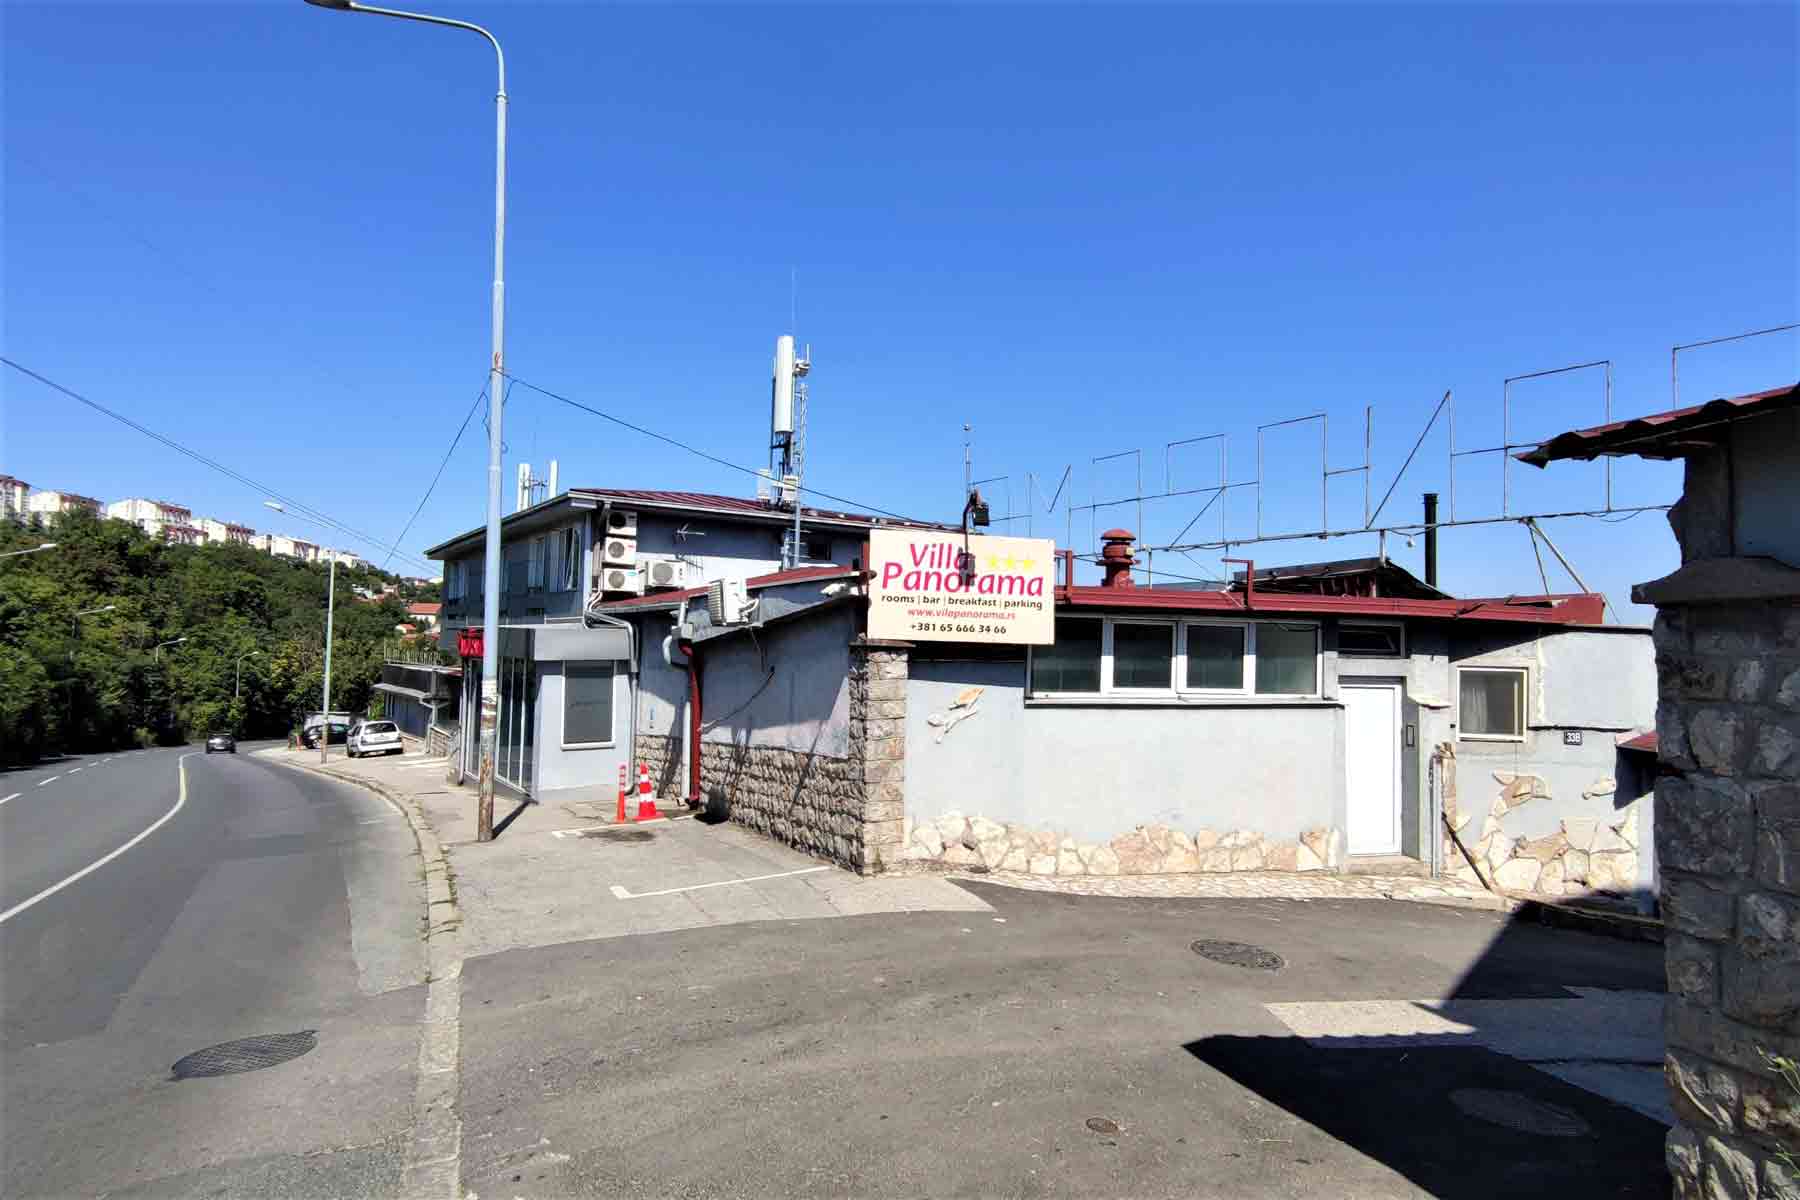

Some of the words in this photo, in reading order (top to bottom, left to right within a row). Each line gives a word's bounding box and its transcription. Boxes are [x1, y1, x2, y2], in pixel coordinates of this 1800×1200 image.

[882, 562, 1044, 597] Panorama
[881, 595, 915, 604] rooms
[922, 595, 940, 605] bar
[948, 596, 997, 607] breakfast
[1004, 599, 1043, 610] parking
[911, 622, 936, 632] +381
[940, 623, 953, 632] 65
[956, 624, 975, 633] 666
[978, 625, 991, 633] 34
[994, 626, 1007, 634] 66
